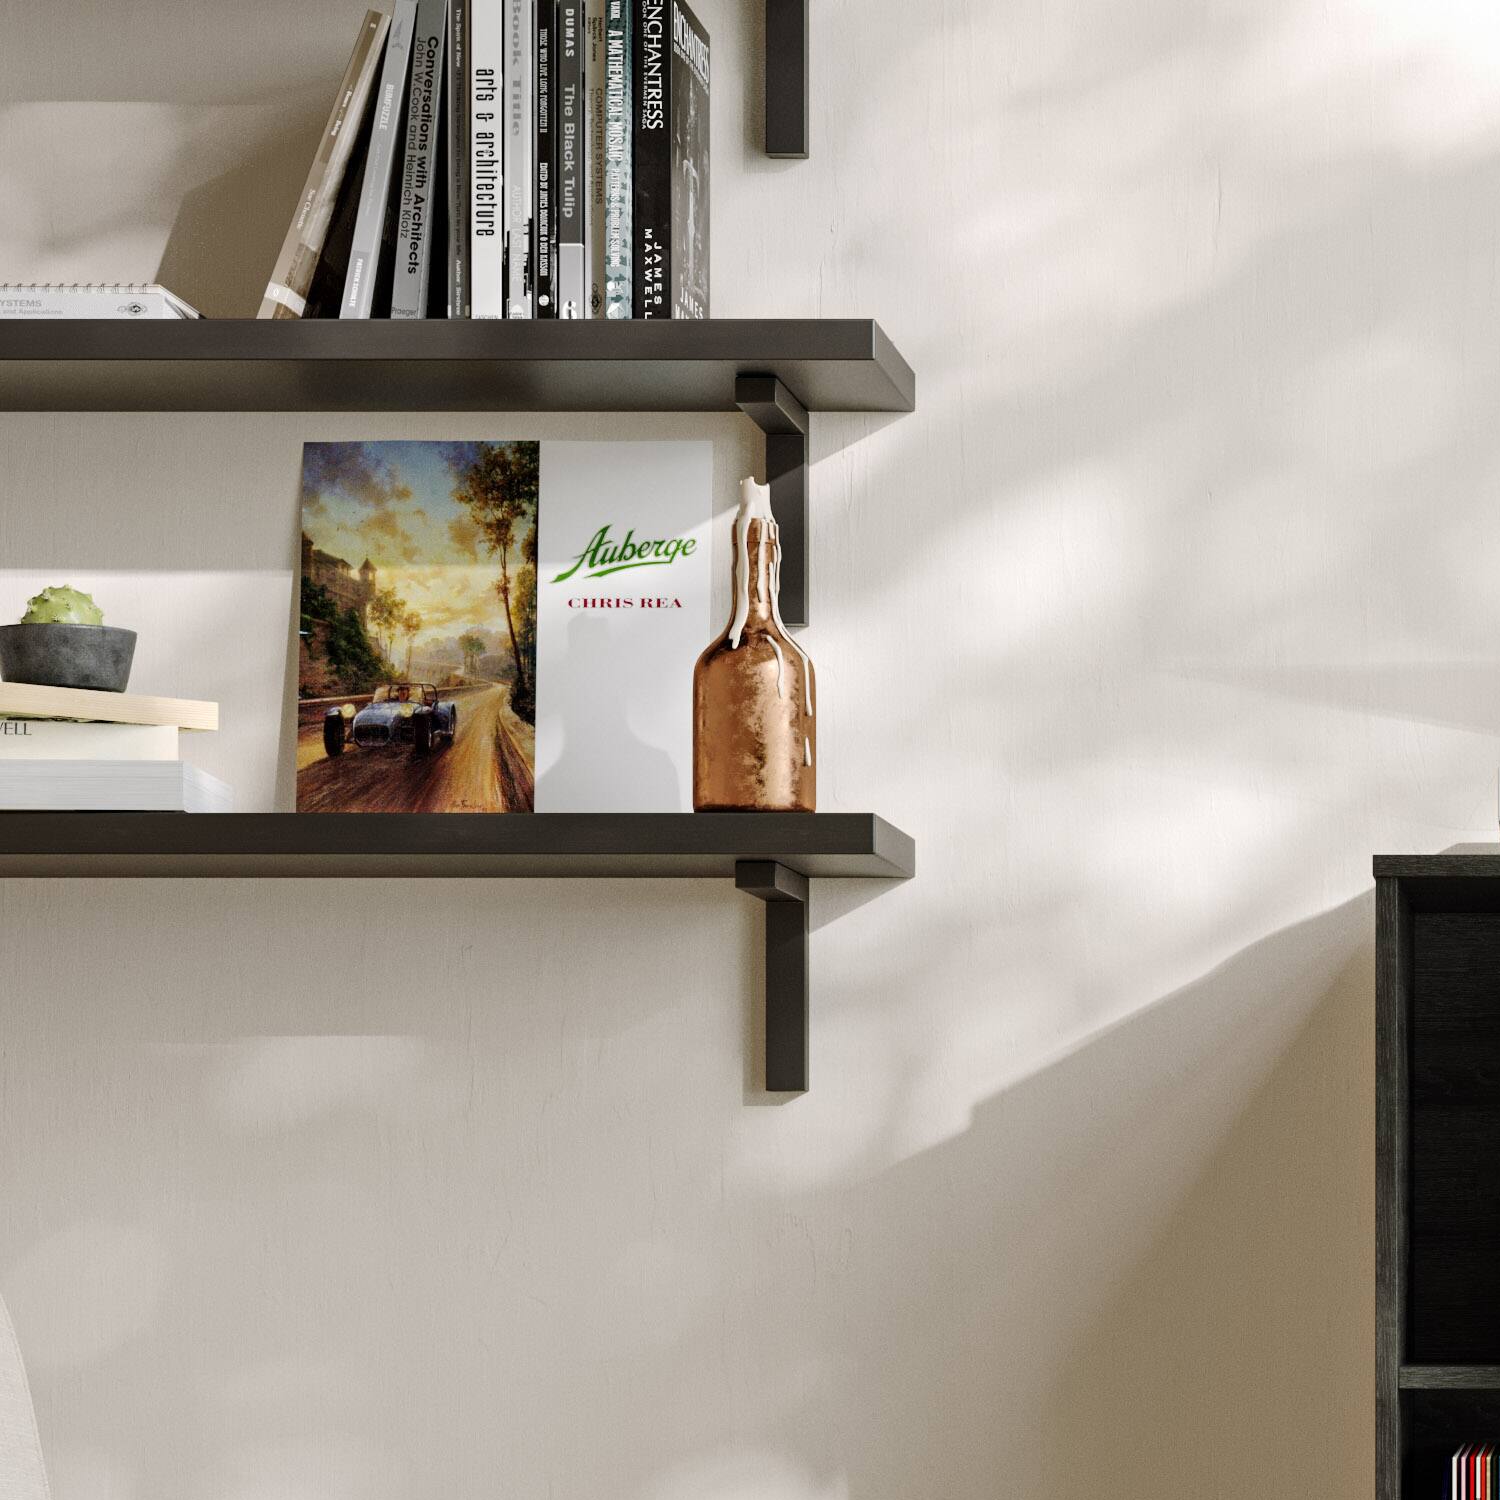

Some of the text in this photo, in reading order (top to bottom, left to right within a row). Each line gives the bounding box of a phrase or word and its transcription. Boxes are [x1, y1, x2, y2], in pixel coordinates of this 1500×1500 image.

[539, 27, 548, 45] THOSE
[565, 8, 575, 57] DUMAS
[642, 41, 648, 51] OF
[673, 1, 710, 85] ENCHANTRESS
[415, 36, 427, 68] John
[511, 0, 522, 136] Book Title
[539, 46, 548, 61] WHO
[539, 62, 548, 75] LIVE
[647, 0, 664, 129] ENCHANTRESS
[539, 76, 548, 92] LONG
[607, 29, 623, 162] A MATHEMATICAL MOSAIC
[379, 83, 395, 130] BUMFUZZLE
[539, 93, 548, 126] FORGOTTEN
[407, 124, 420, 151] and
[476, 68, 499, 236] arts & architecture
[562, 83, 576, 218] The Black Tulip
[595, 87, 603, 205] COMPUTER SYSTEMS
[407, 36, 438, 275] Conversations with Architects
[402, 154, 417, 206] Heinrich
[610, 168, 620, 200] PATTERNS
[400, 209, 412, 239] Klotz
[610, 209, 620, 238] PROBLEM
[610, 239, 620, 267] SOLVING
[644, 227, 653, 319] MAXWELL
[653, 241, 663, 305] JAMES
[0, 299, 43, 307] YSTEMS
[680, 286, 704, 320] JAMES
[550, 523, 697, 583] Auberge
[567, 597, 684, 609] CHRIS REA
[0, 722, 32, 735] ELL
